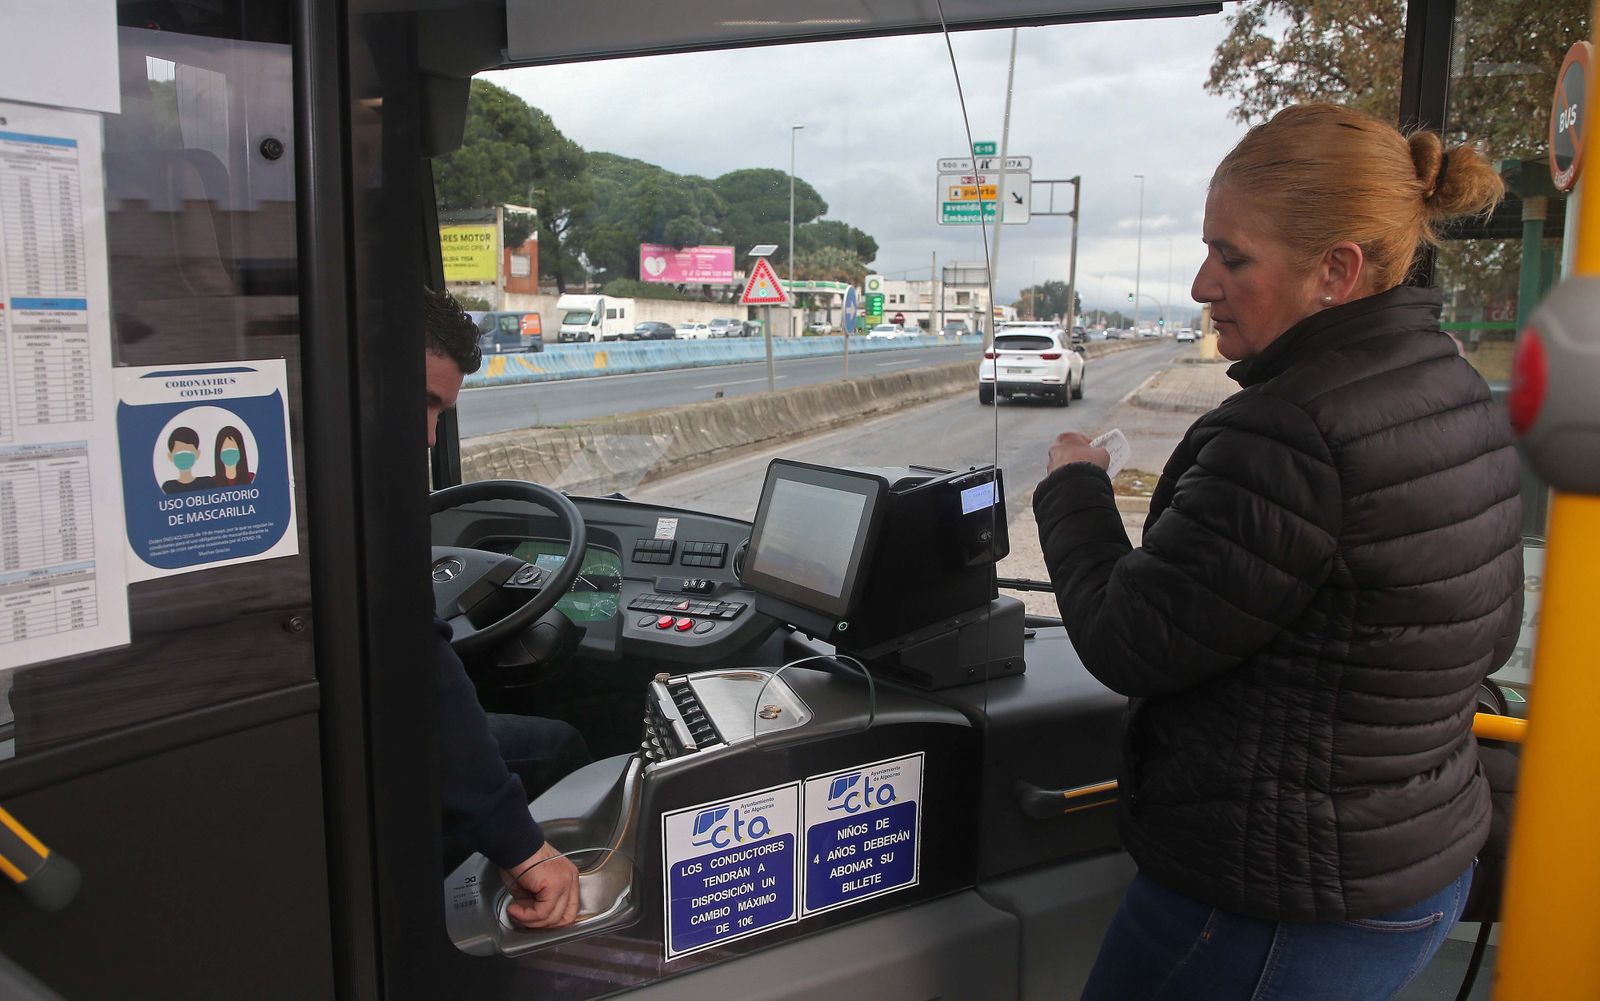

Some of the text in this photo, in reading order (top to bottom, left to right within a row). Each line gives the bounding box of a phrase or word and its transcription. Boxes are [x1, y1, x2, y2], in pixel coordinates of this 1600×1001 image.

[1559, 104, 1578, 133] BUS
[460, 233, 491, 242] MOTOR
[165, 377, 236, 389] CORONAVIRUS
[180, 388, 223, 397] COVID-19
[159, 488, 259, 511] USO OBLIGATORIO
[168, 504, 256, 526] DE MASCARILLA
[870, 766, 901, 776] Ayuntamiento
[880, 772, 900, 780] Algeciras
[740, 796, 774, 809] Ayuntamiento
[751, 803, 774, 813] Algeciras
[837, 818, 890, 840] NIÑOS DE
[813, 829, 910, 864] 4 AÑOS DEBERÁN
[682, 841, 784, 877] LOS CONDUCTORES
[830, 852, 894, 879] ABONAR SU
[703, 863, 765, 888] TENDRÁN A
[842, 873, 882, 893] BILLETE
[691, 877, 775, 908] DISPOSICIÓN UN
[690, 893, 776, 925] CAMBIO MÁXIMO
[715, 915, 753, 935] DE 10€
